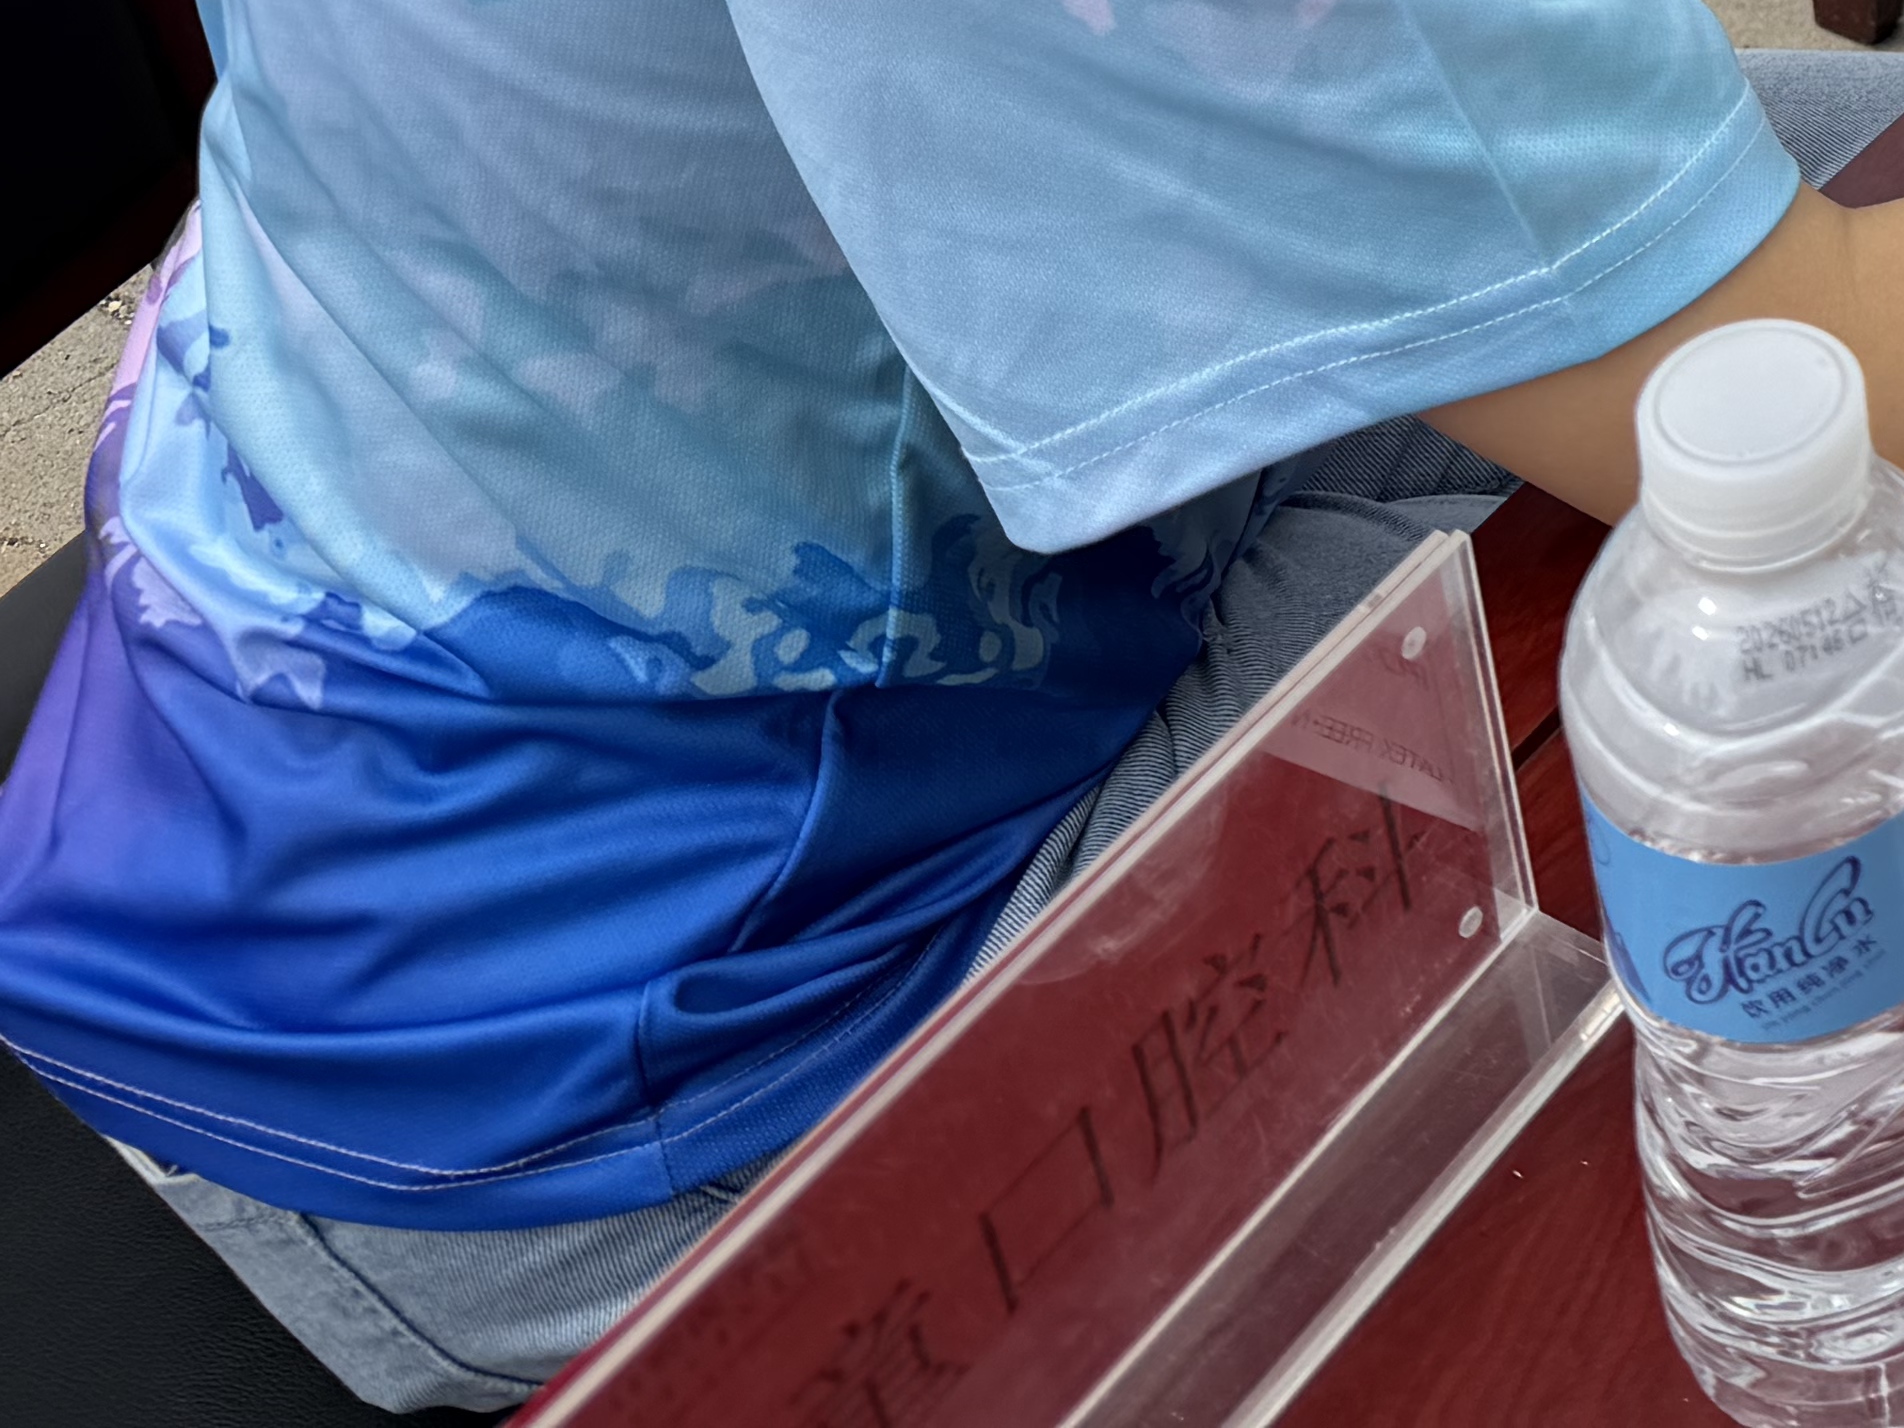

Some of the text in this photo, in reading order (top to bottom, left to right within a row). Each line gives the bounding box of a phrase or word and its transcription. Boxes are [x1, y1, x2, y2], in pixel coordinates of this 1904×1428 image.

[1741, 933, 1877, 1020] 饮用纯净水
